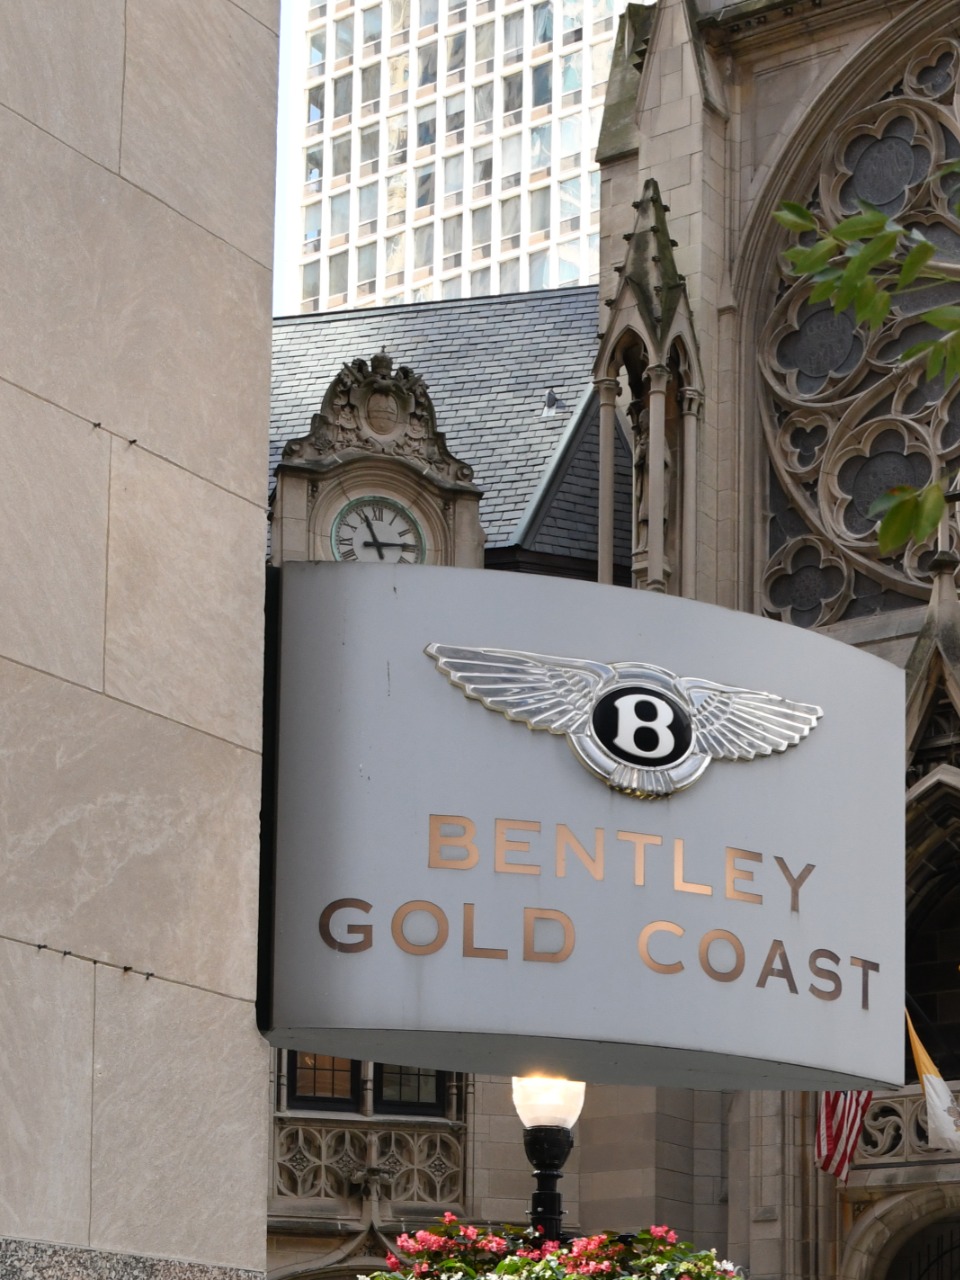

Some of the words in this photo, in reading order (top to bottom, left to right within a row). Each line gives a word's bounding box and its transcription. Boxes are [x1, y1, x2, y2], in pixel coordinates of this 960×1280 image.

[613, 694, 675, 759] B
[427, 813, 817, 914] BENTLEY
[318, 897, 576, 964] GOLD
[637, 919, 881, 1011] COAST
